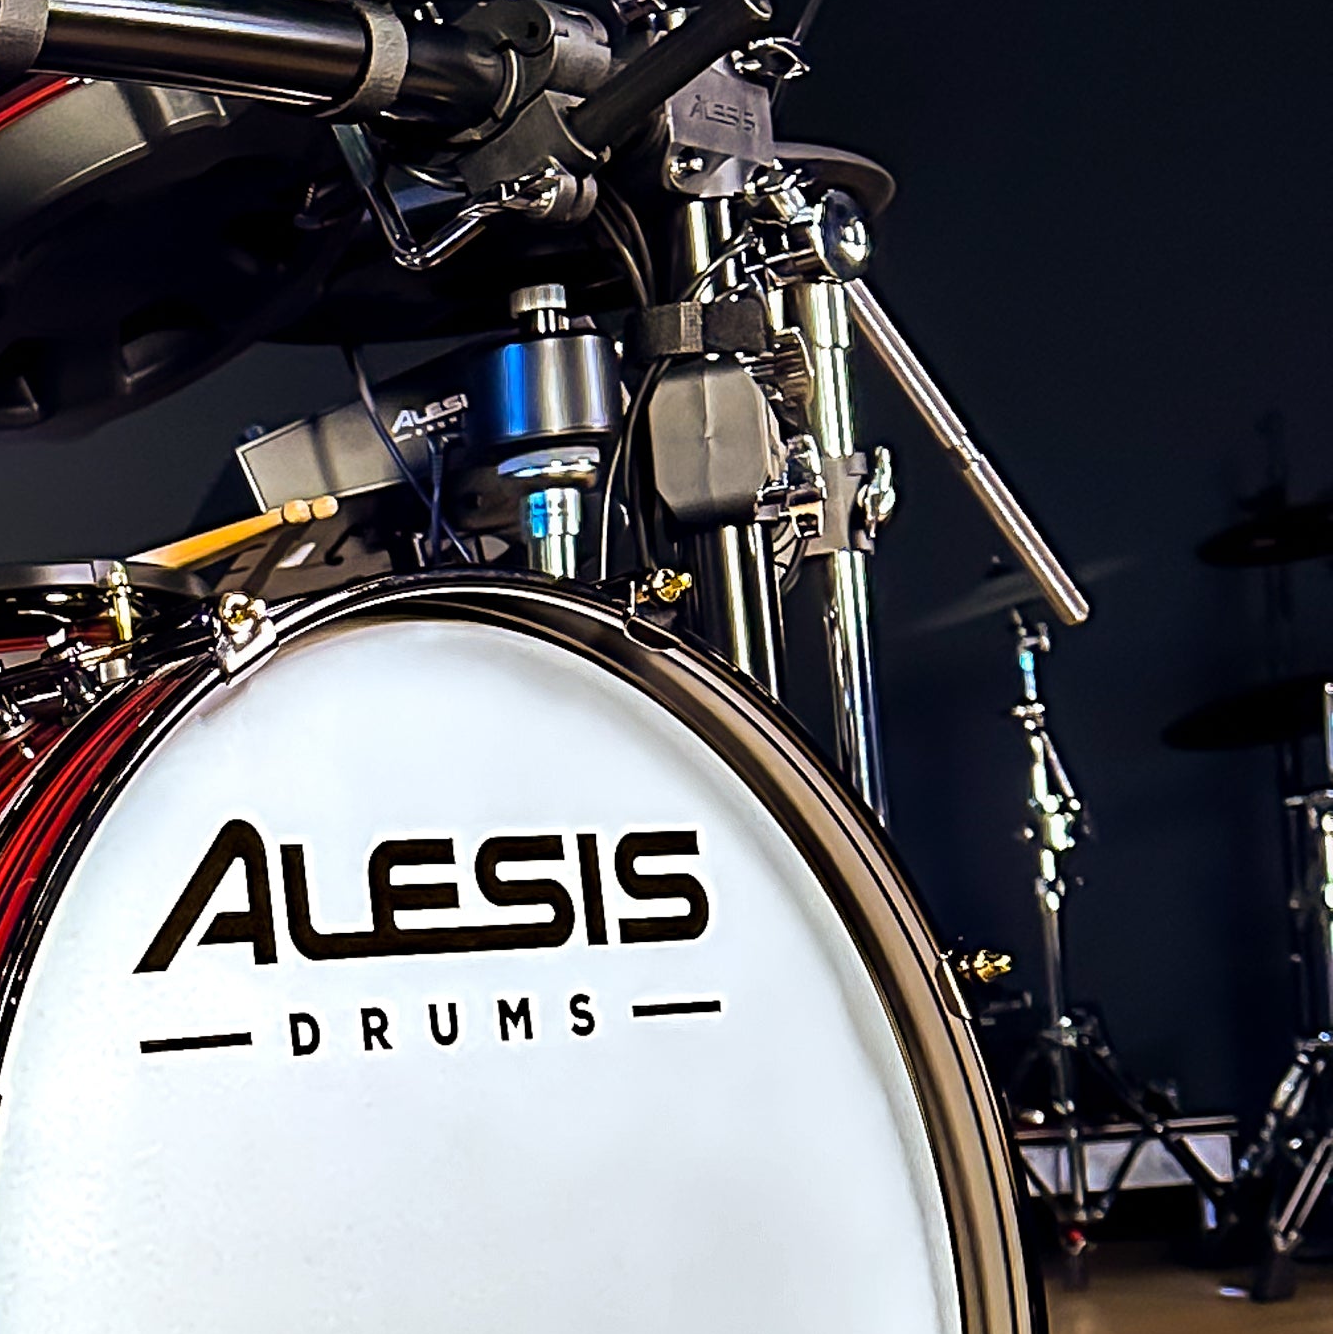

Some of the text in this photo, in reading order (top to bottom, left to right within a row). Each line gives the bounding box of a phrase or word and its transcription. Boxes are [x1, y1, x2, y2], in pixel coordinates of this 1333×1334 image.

[390, 393, 469, 435] ALESI
[133, 818, 710, 974] ALESIS
[290, 993, 596, 1057] DRUMS
